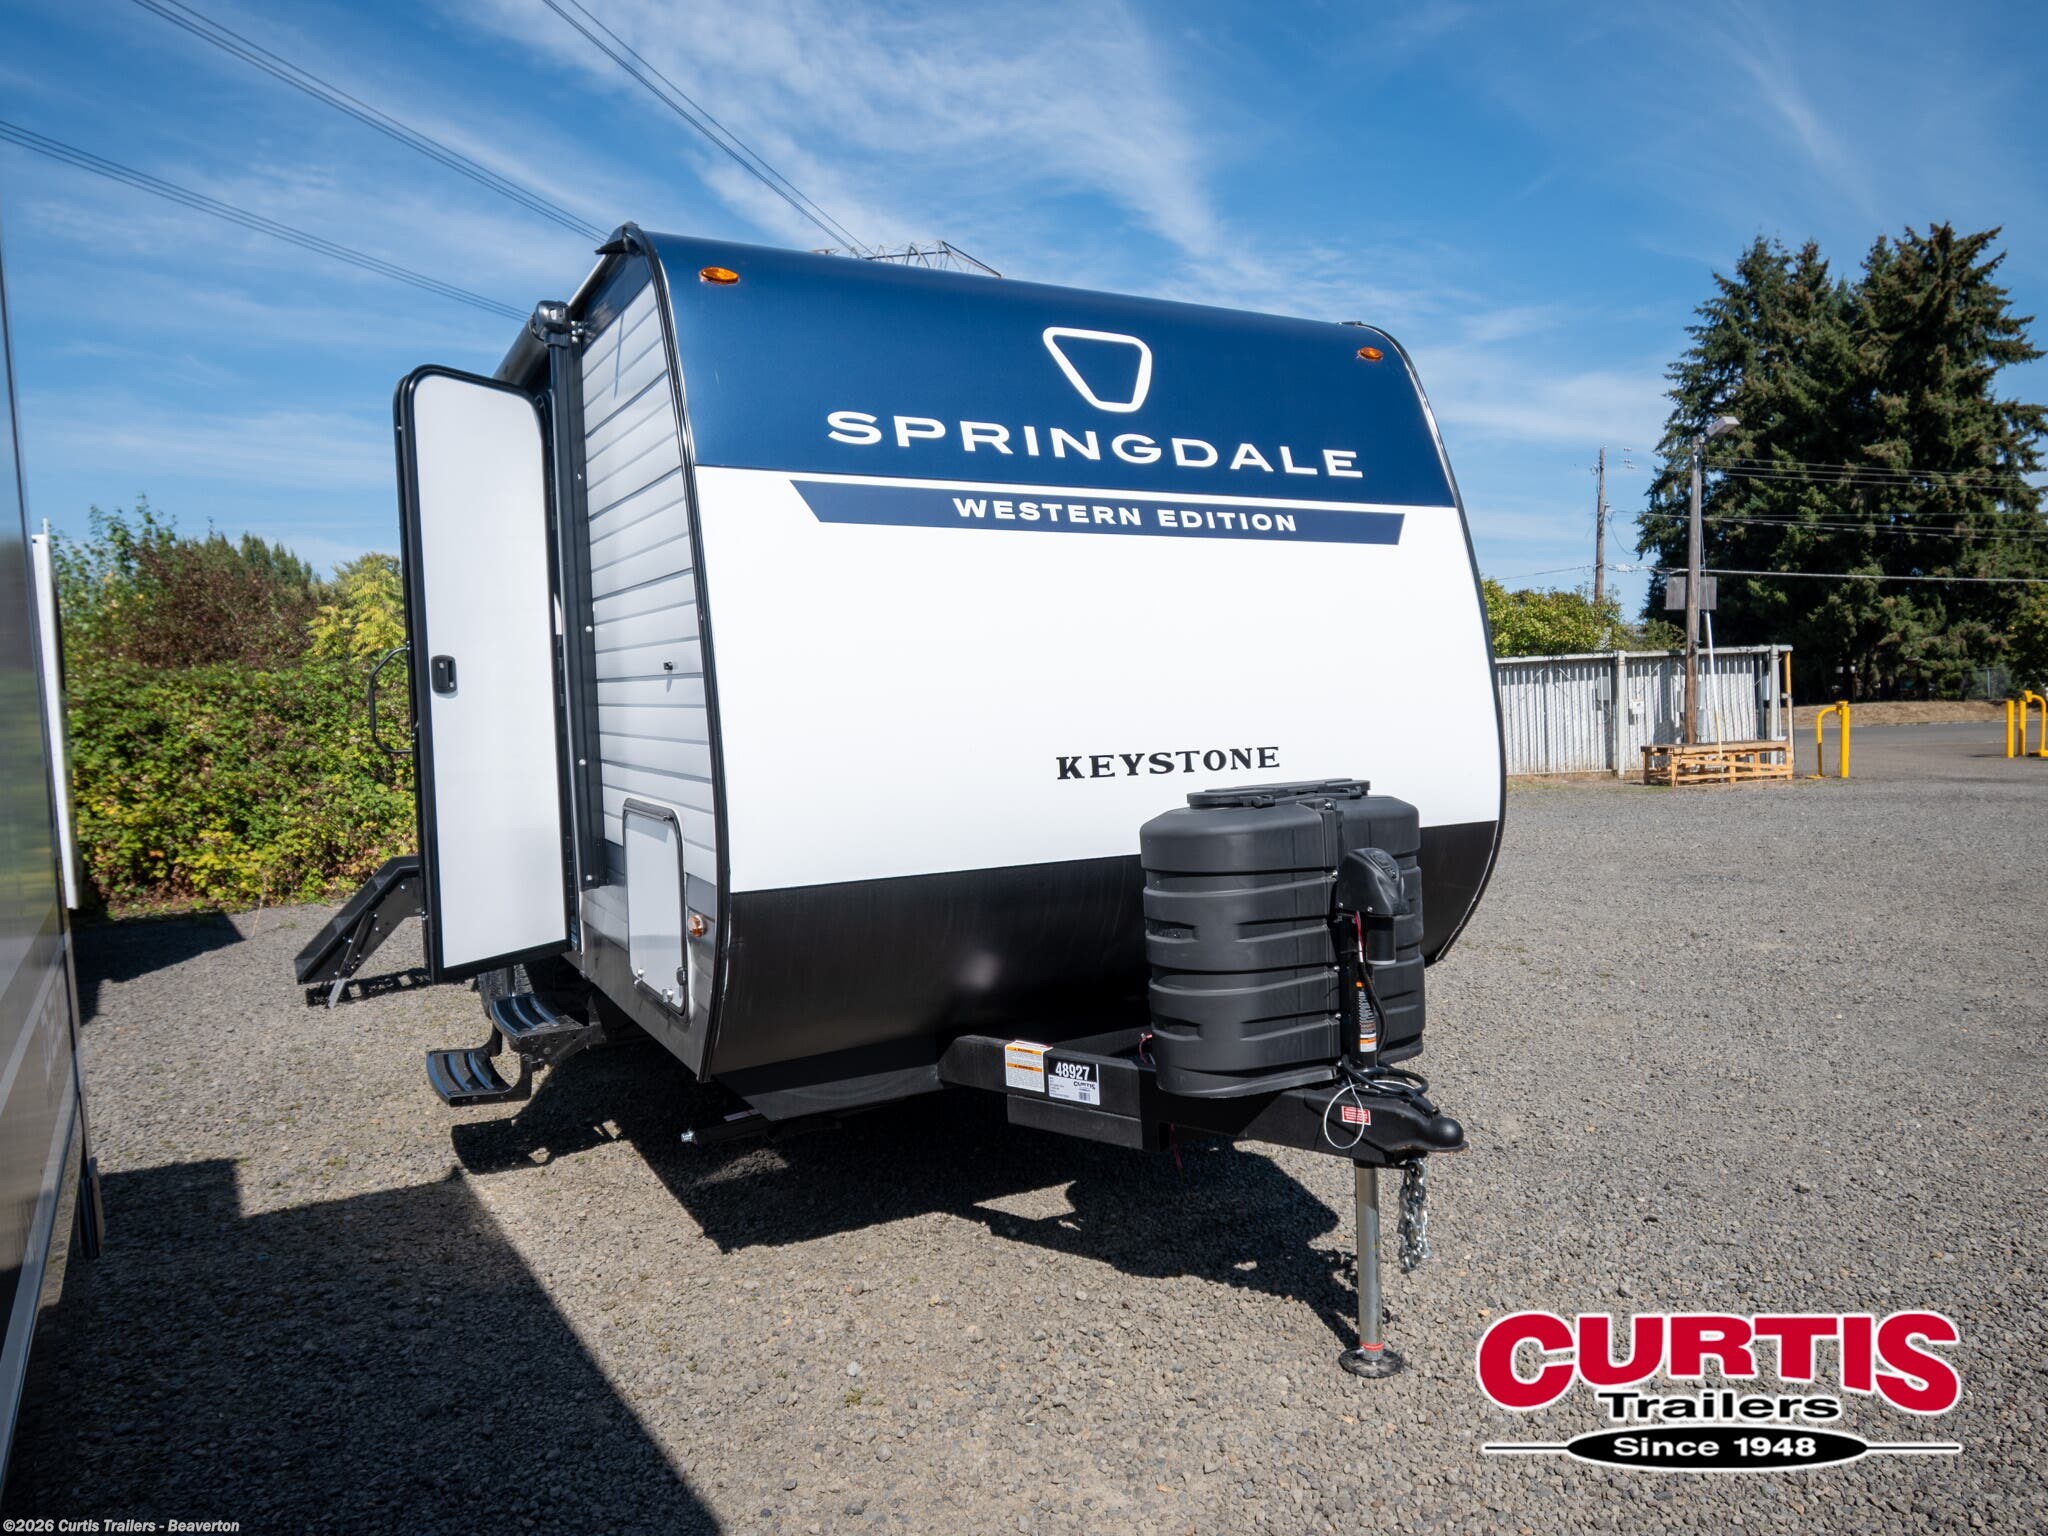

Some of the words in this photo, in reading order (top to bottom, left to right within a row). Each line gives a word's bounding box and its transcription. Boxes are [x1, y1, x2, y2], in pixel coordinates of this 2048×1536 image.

[827, 410, 1364, 479] SPRINGDALE
[952, 497, 1142, 526] WESTERN
[1157, 507, 1297, 532] EDITION
[1055, 746, 1281, 780] KEYSTONE
[1055, 1061, 1090, 1081] 48927
